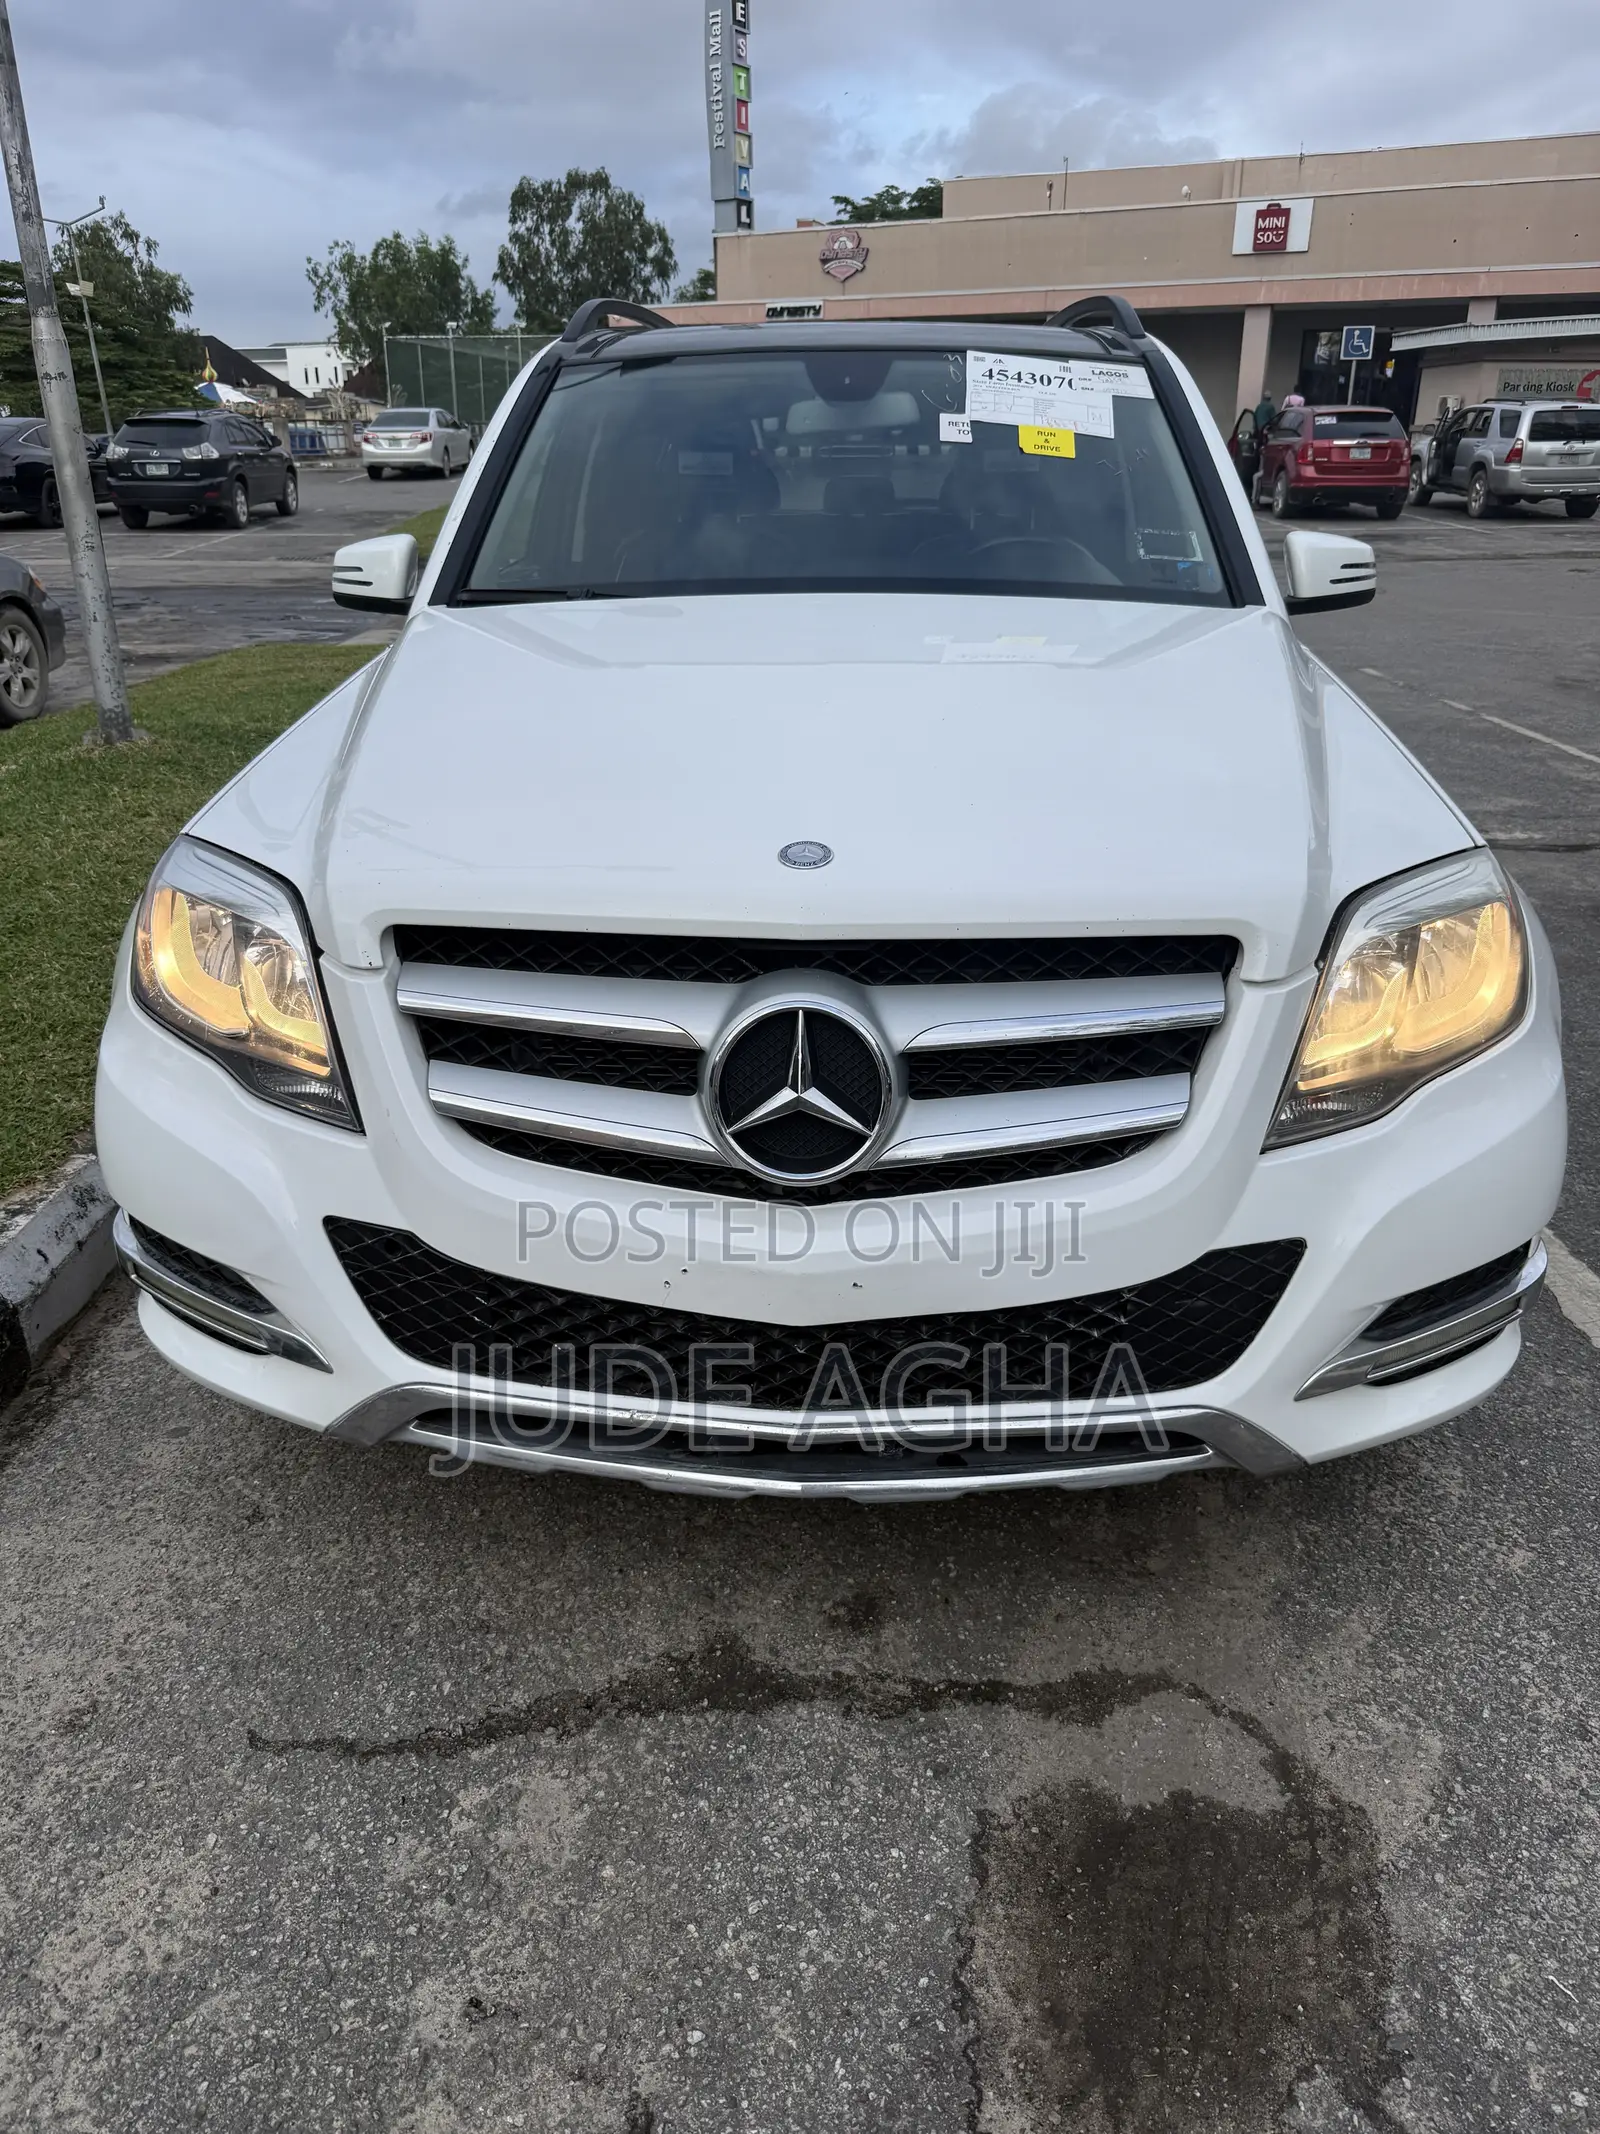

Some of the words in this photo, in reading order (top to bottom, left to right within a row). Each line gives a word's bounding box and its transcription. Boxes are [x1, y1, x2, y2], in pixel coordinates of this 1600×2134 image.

[709, 8, 722, 57] Mall
[709, 62, 725, 149] Festival
[1257, 216, 1286, 229] MINI
[1091, 369, 1129, 379] LAGOS
[1546, 381, 1575, 392] Kiosk
[1037, 430, 1056, 438] RUN
[1033, 444, 1061, 453] DRIVE
